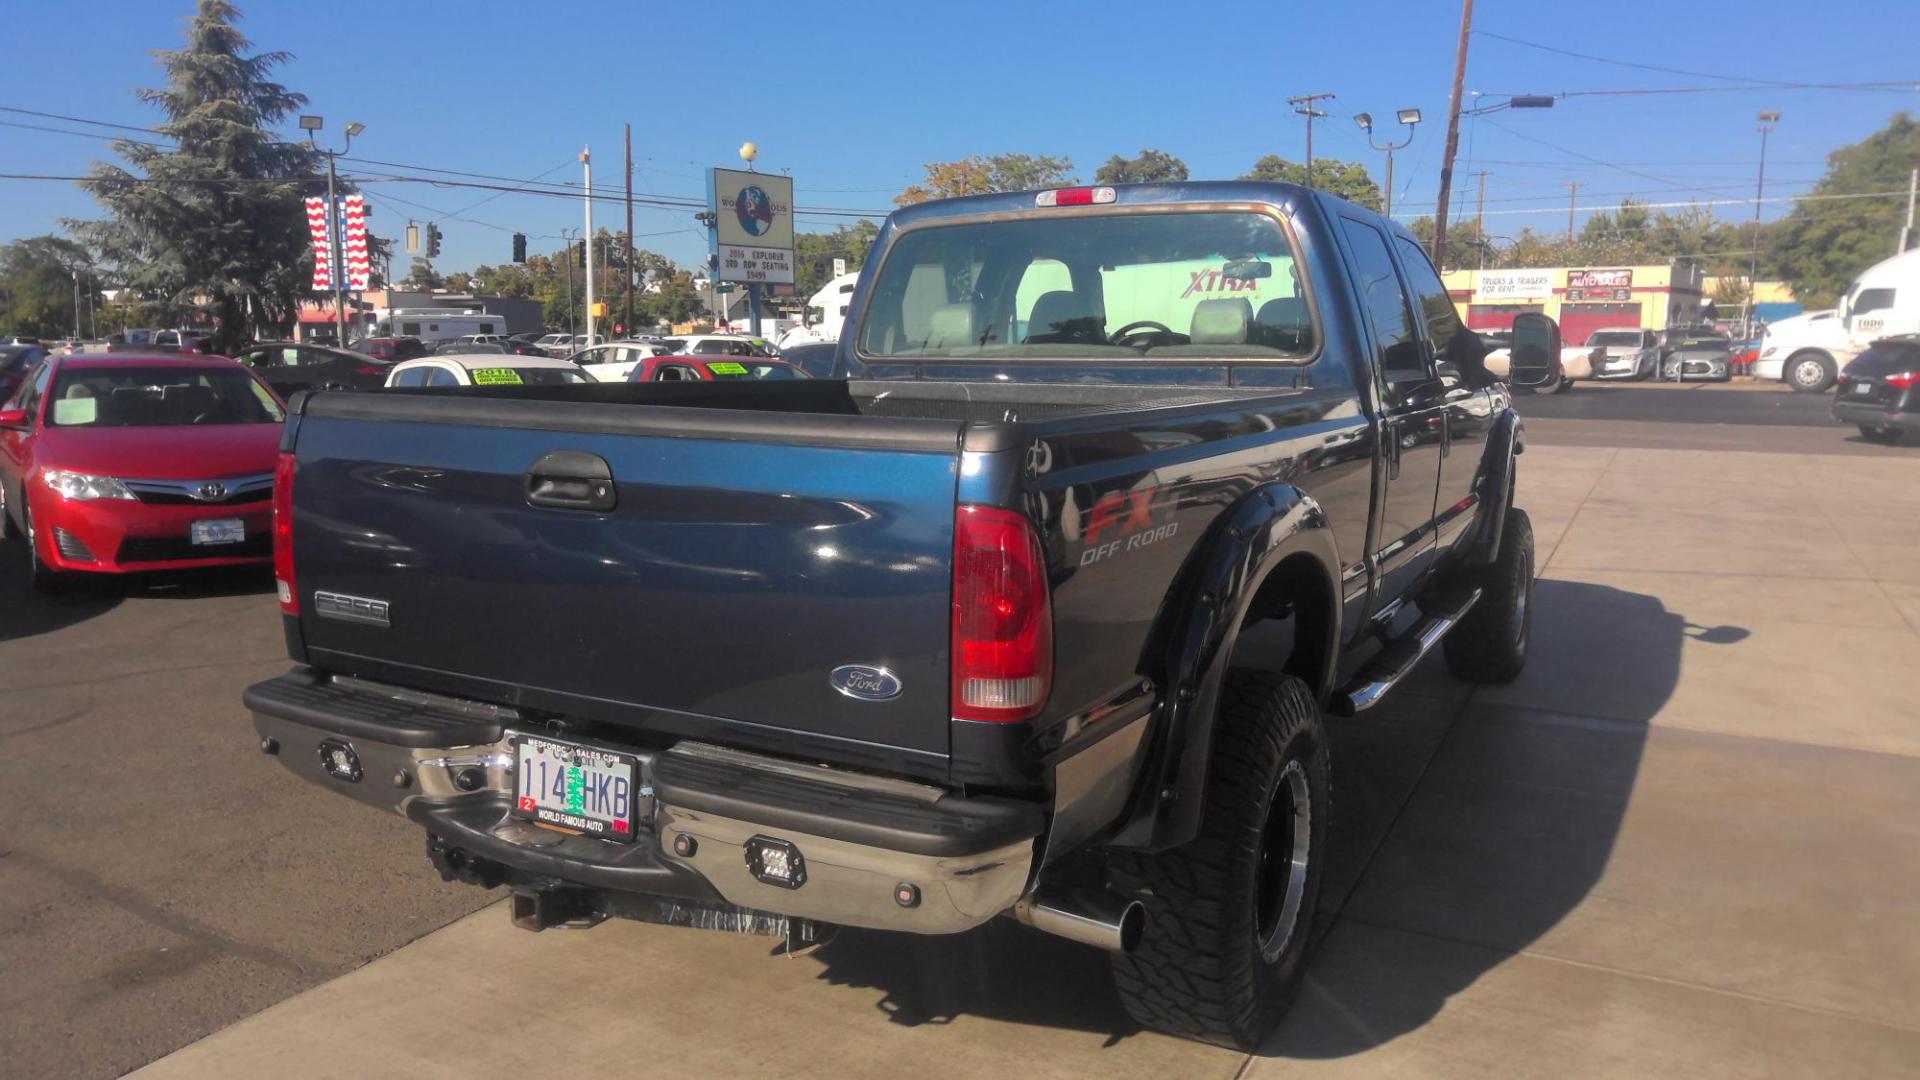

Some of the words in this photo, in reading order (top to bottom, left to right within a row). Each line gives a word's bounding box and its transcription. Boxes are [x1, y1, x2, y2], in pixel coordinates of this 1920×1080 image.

[752, 251, 785, 261] EXPLORER
[743, 261, 757, 269] ROW
[762, 262, 789, 271] SEATING
[1482, 277, 1506, 285] TRUCKS
[1517, 276, 1548, 285] TRAILERS
[1571, 278, 1595, 287] AUTO
[1597, 277, 1628, 286] SALES
[1498, 285, 1516, 293] RENT
[1080, 540, 1122, 567] OFF
[1127, 522, 1178, 552] ROAD
[847, 670, 883, 691] Ford
[524, 758, 566, 805] 114
[583, 770, 629, 819] HKB
[524, 799, 531, 810] 2
[538, 809, 560, 822] WORLD
[560, 812, 586, 829] FAMOUS
[586, 819, 603, 832] AUTO
